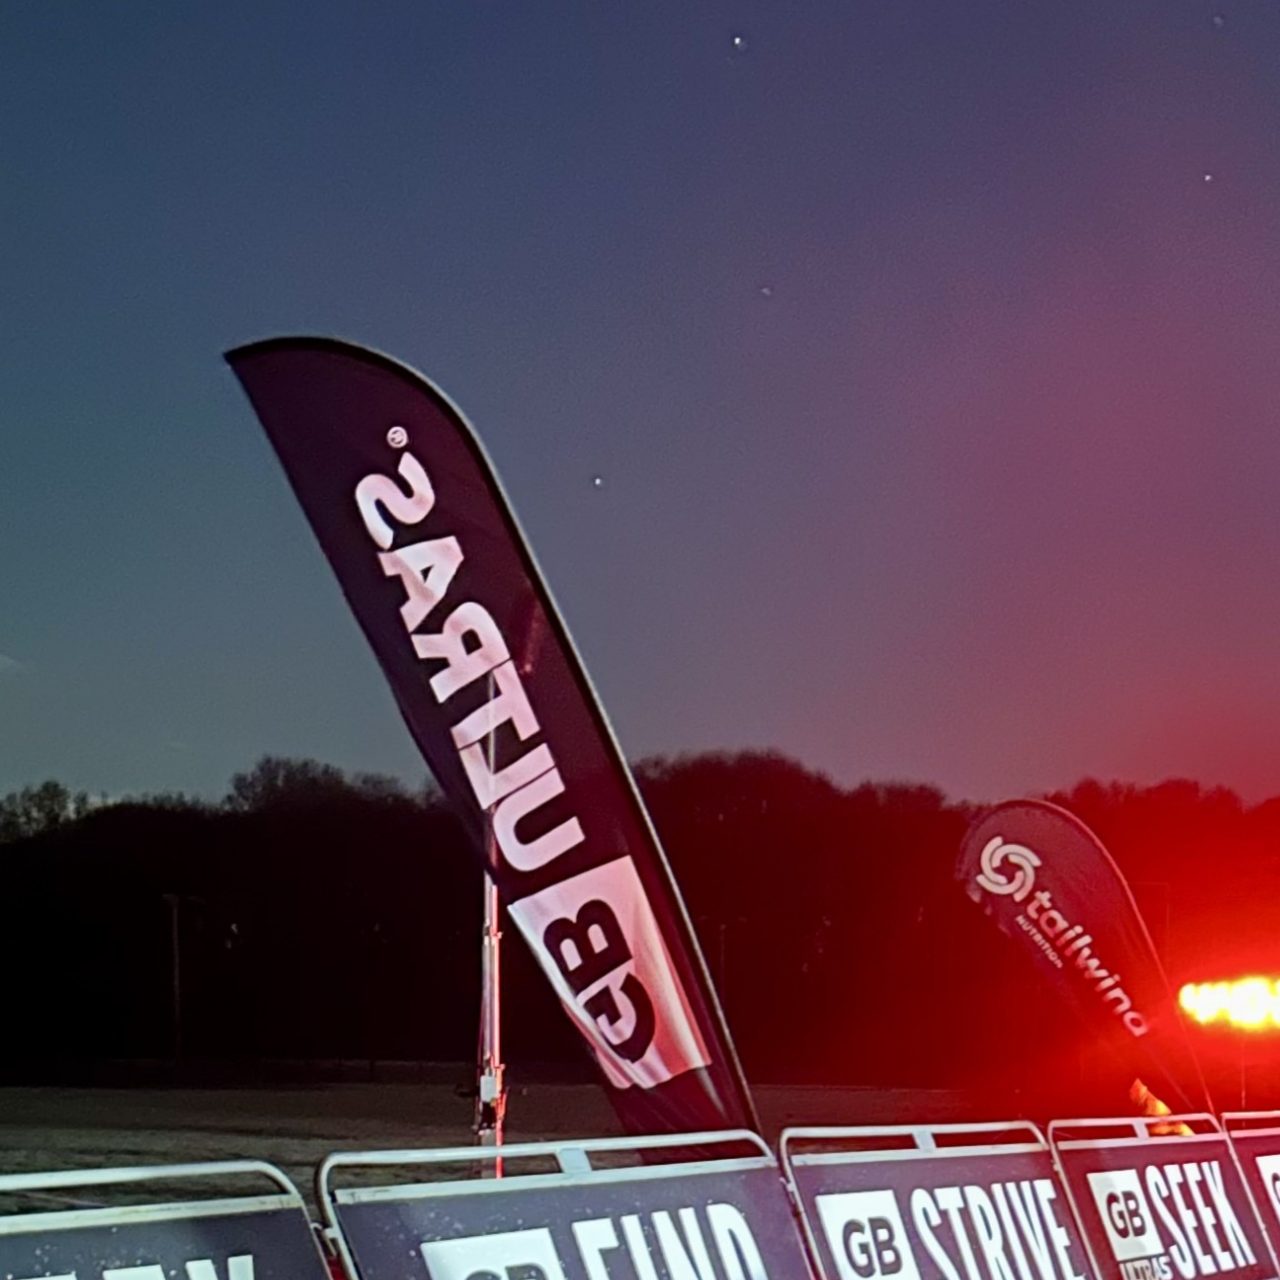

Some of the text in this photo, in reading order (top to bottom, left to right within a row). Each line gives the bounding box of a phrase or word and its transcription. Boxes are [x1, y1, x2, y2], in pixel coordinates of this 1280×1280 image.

[843, 1217, 902, 1279] GB
[1107, 1160, 1257, 1280] GB SEEK
